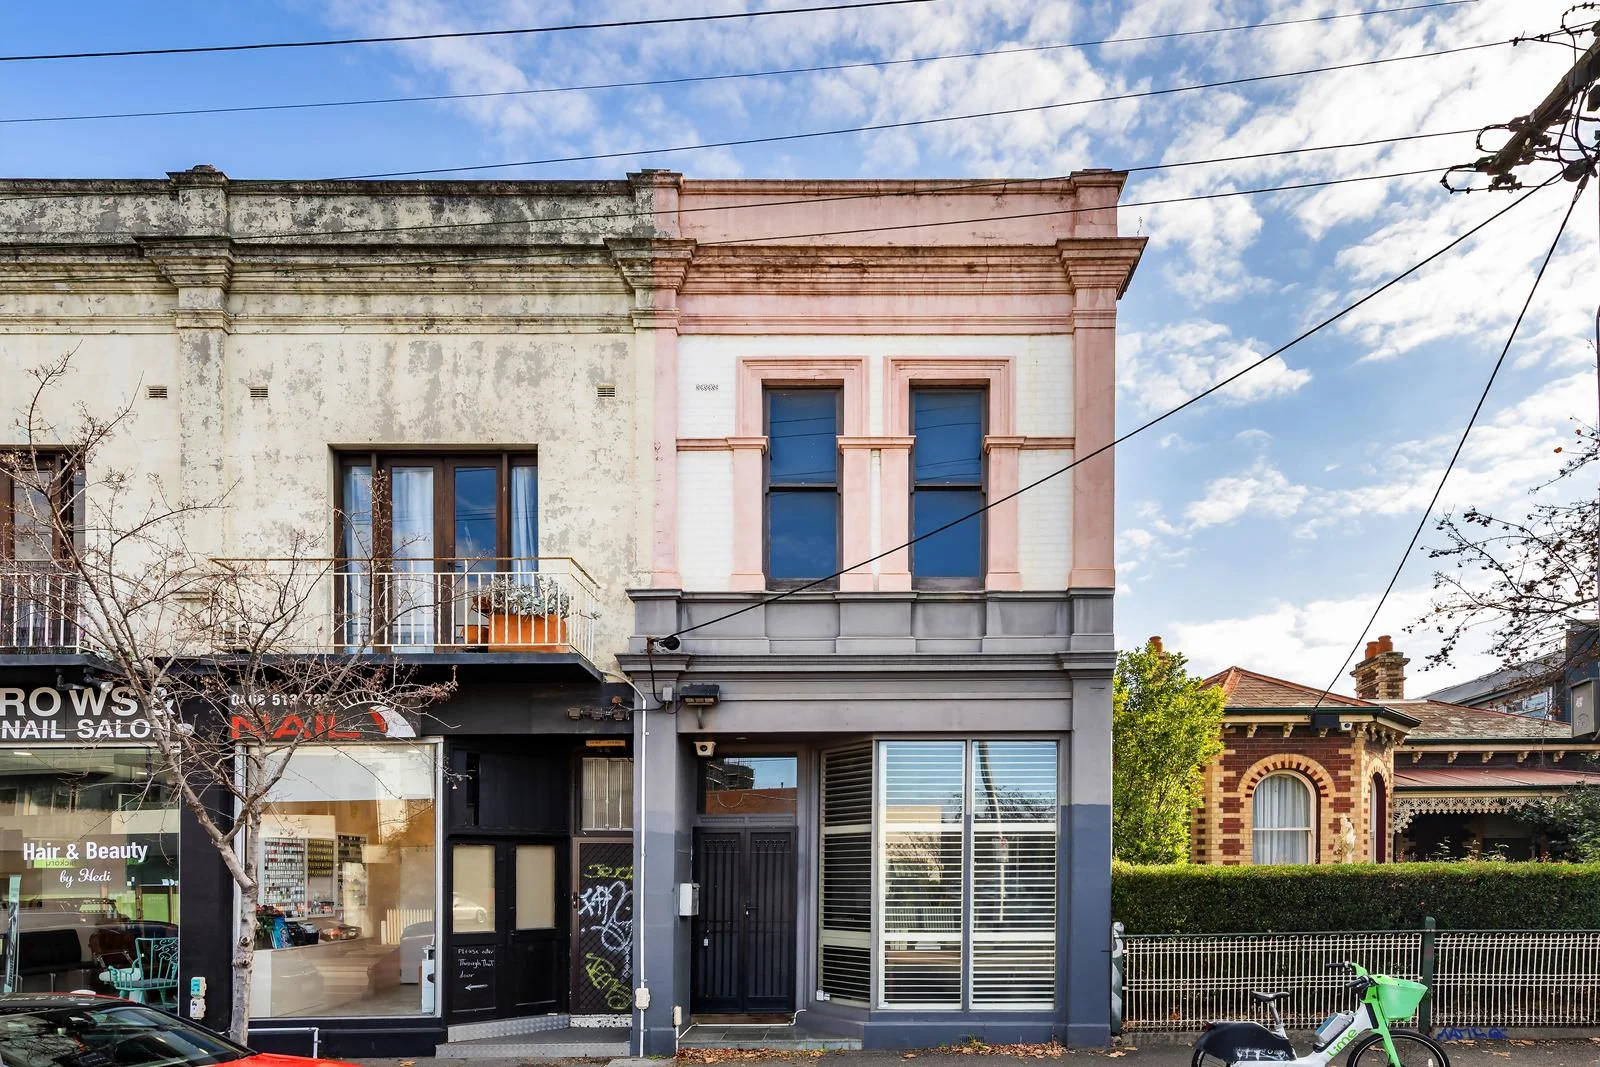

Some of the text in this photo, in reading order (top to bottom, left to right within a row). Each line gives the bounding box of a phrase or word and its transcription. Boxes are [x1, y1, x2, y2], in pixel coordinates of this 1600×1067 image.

[1, 719, 171, 740] NAIL SALO
[231, 714, 361, 740] NAIL
[23, 841, 148, 863] Hair & Beauty
[59, 868, 112, 888] by Hedi
[1327, 1029, 1357, 1057] Lime
